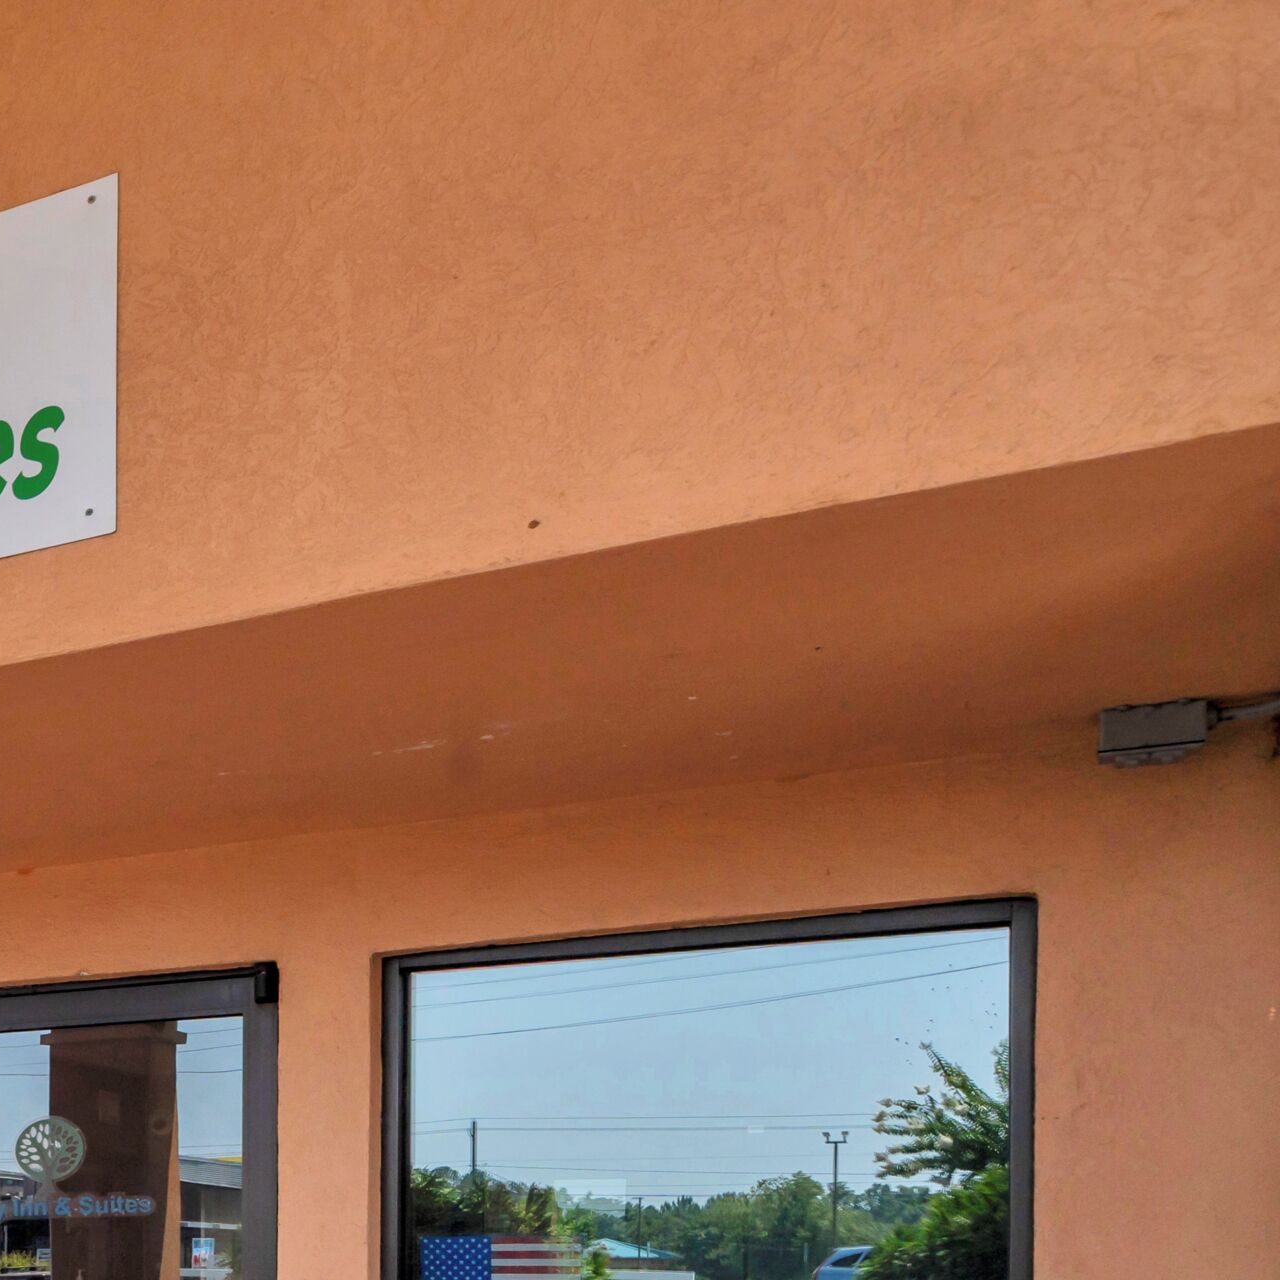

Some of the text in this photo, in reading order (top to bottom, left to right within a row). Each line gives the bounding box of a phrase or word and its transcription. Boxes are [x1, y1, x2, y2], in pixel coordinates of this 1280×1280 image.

[11, 1198, 48, 1217] Inn
[54, 1195, 71, 1217] &
[78, 1194, 154, 1217] Suites
